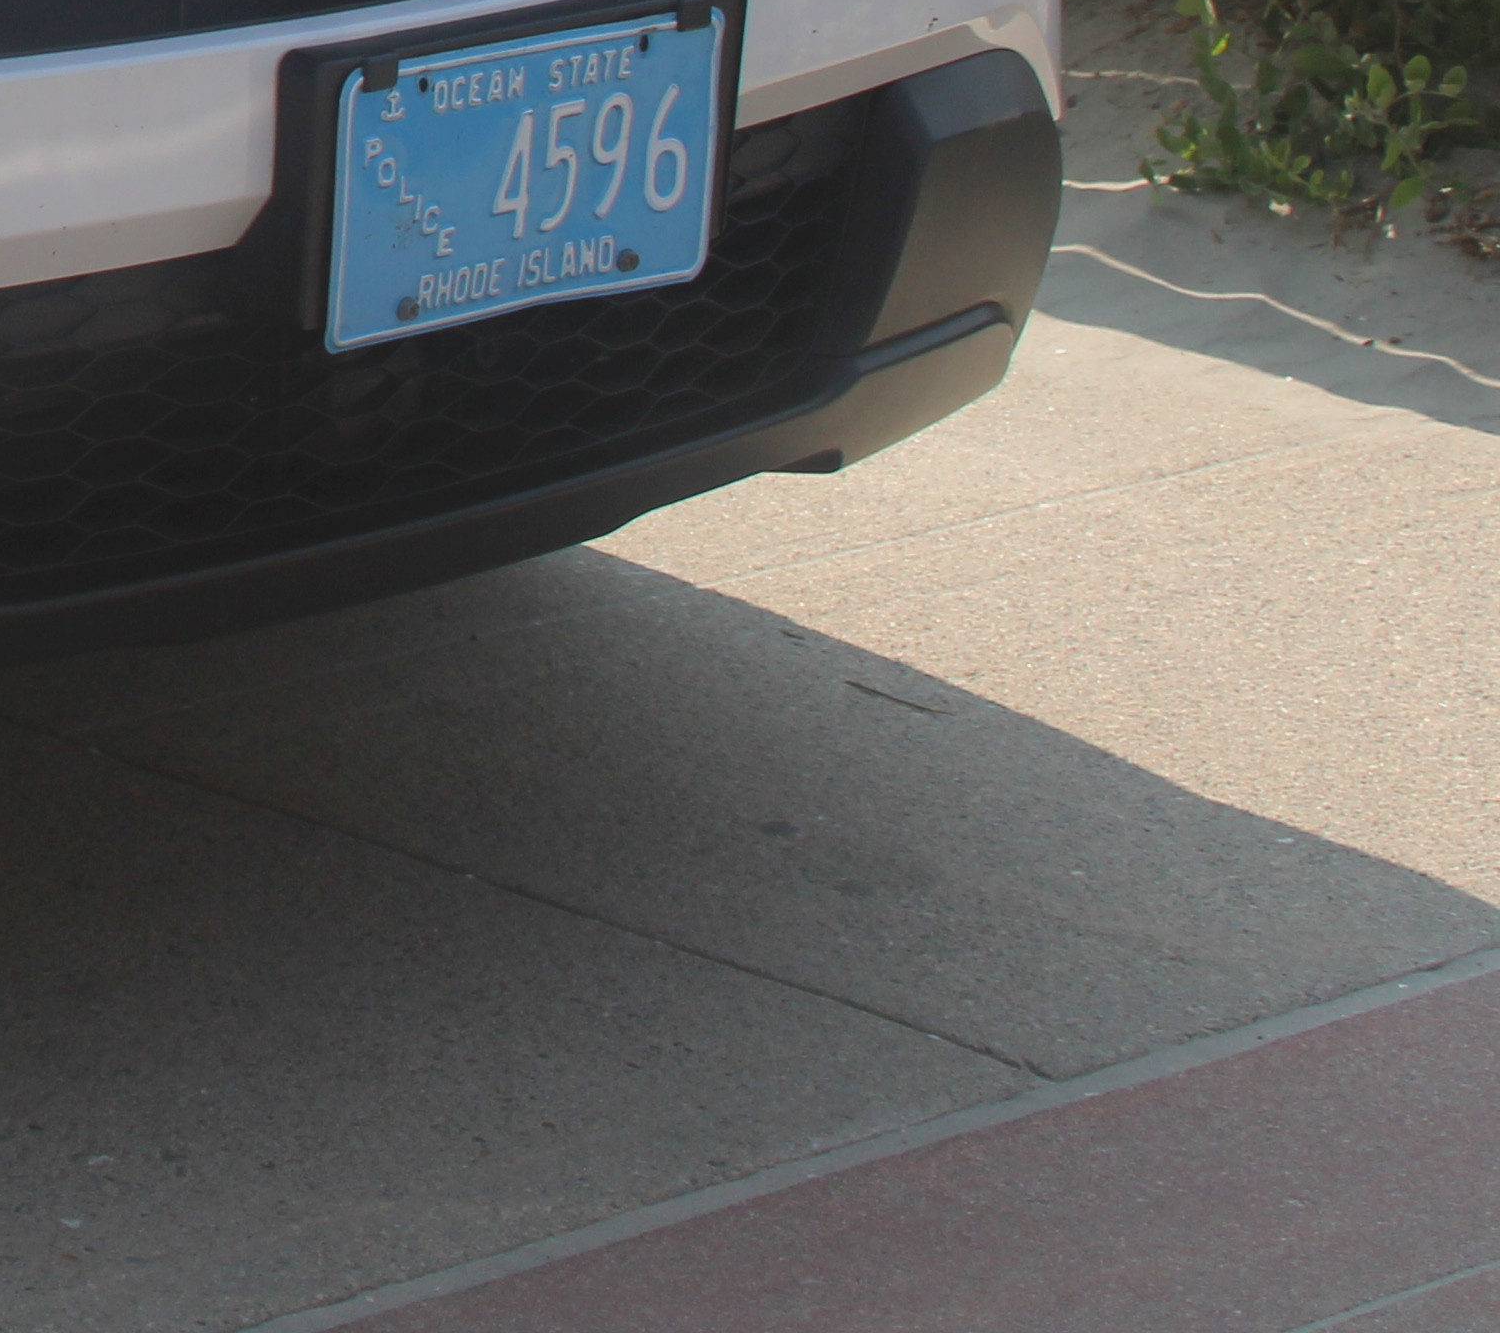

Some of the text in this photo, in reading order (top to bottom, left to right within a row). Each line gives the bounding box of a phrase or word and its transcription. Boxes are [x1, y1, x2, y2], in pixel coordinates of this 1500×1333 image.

[433, 45, 635, 114] OCEAN STATE
[363, 137, 457, 258] POLICE
[492, 83, 688, 240] 4596
[417, 235, 618, 310] RHODE ISLAND
